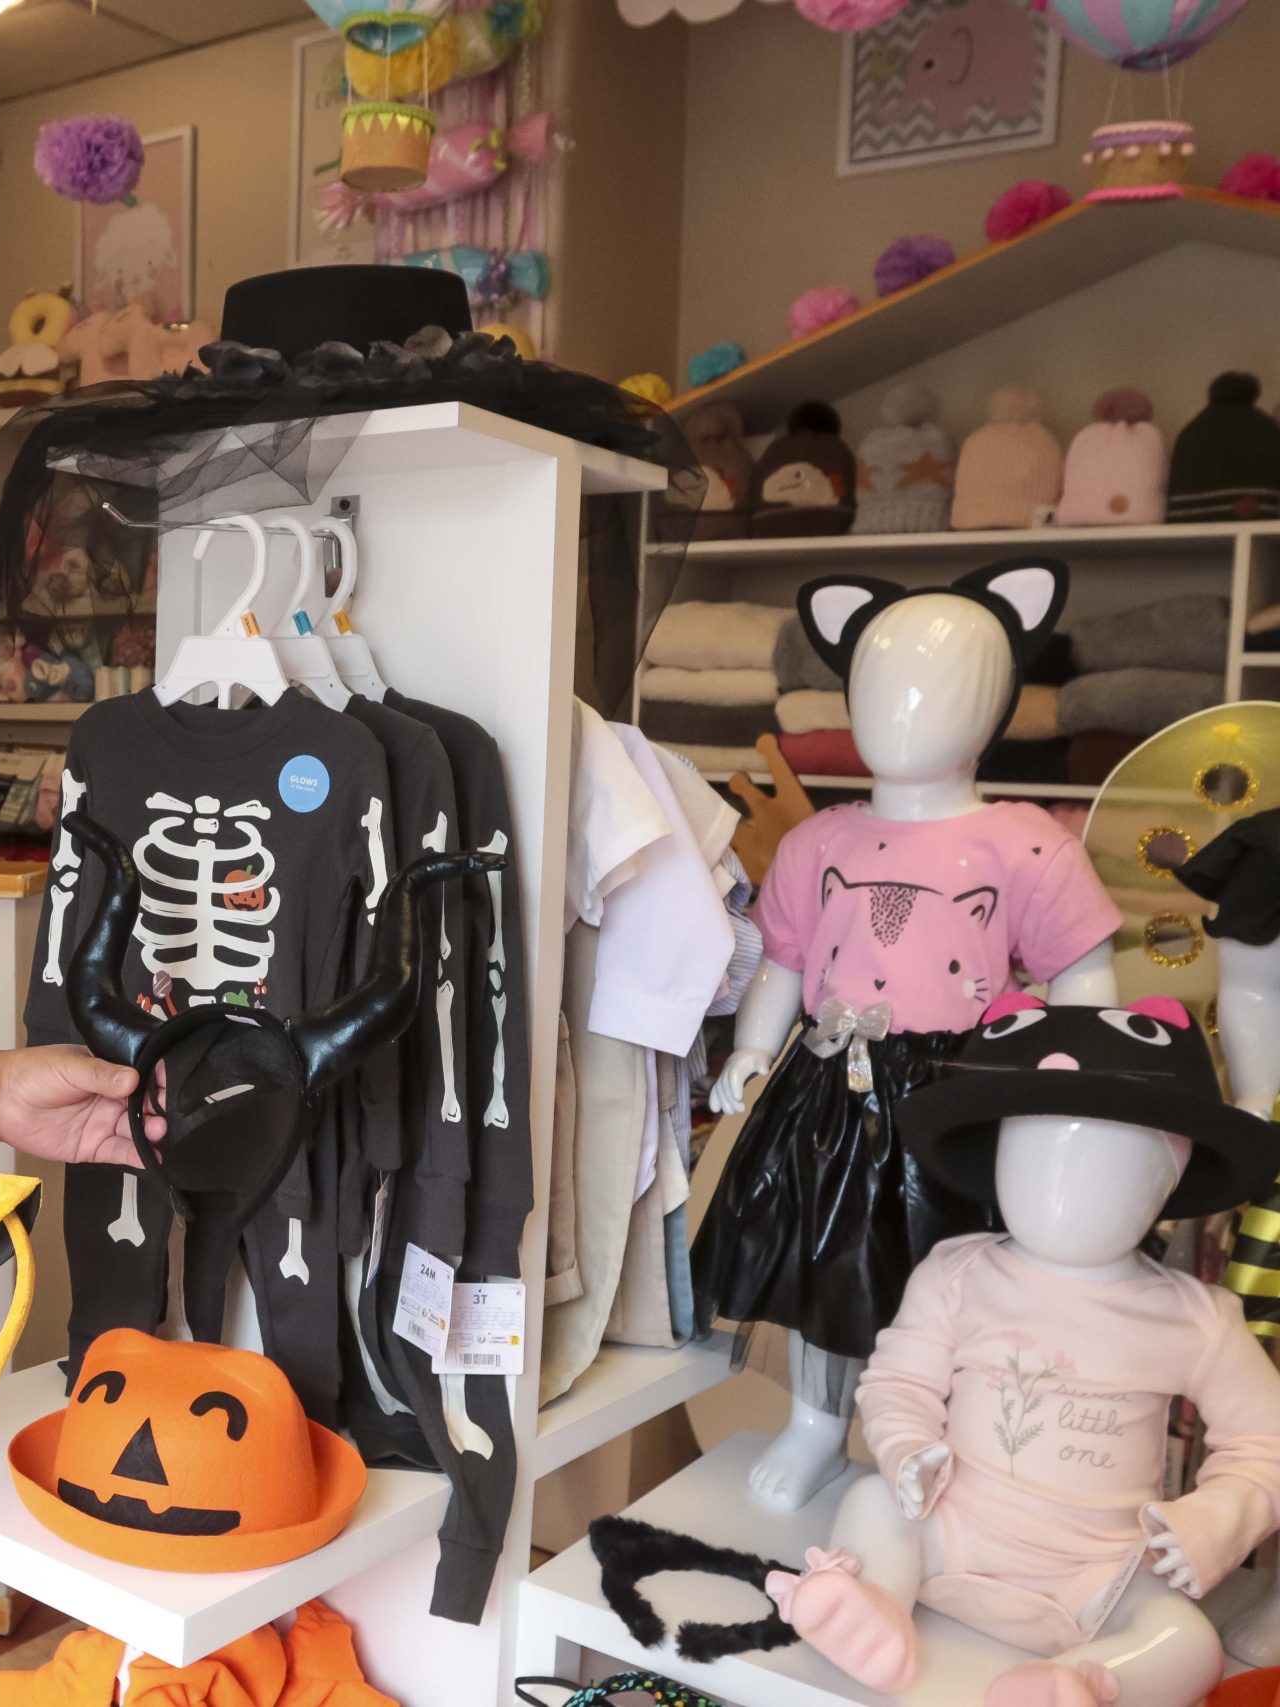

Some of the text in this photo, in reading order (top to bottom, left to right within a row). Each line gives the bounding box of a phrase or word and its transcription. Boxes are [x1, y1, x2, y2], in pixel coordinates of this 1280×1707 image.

[290, 775, 318, 787] GLOWS
[420, 1263, 436, 1281] 24M
[473, 1294, 487, 1305] 3T
[1058, 1400, 1125, 1436] little
[1059, 1445, 1116, 1469] one
